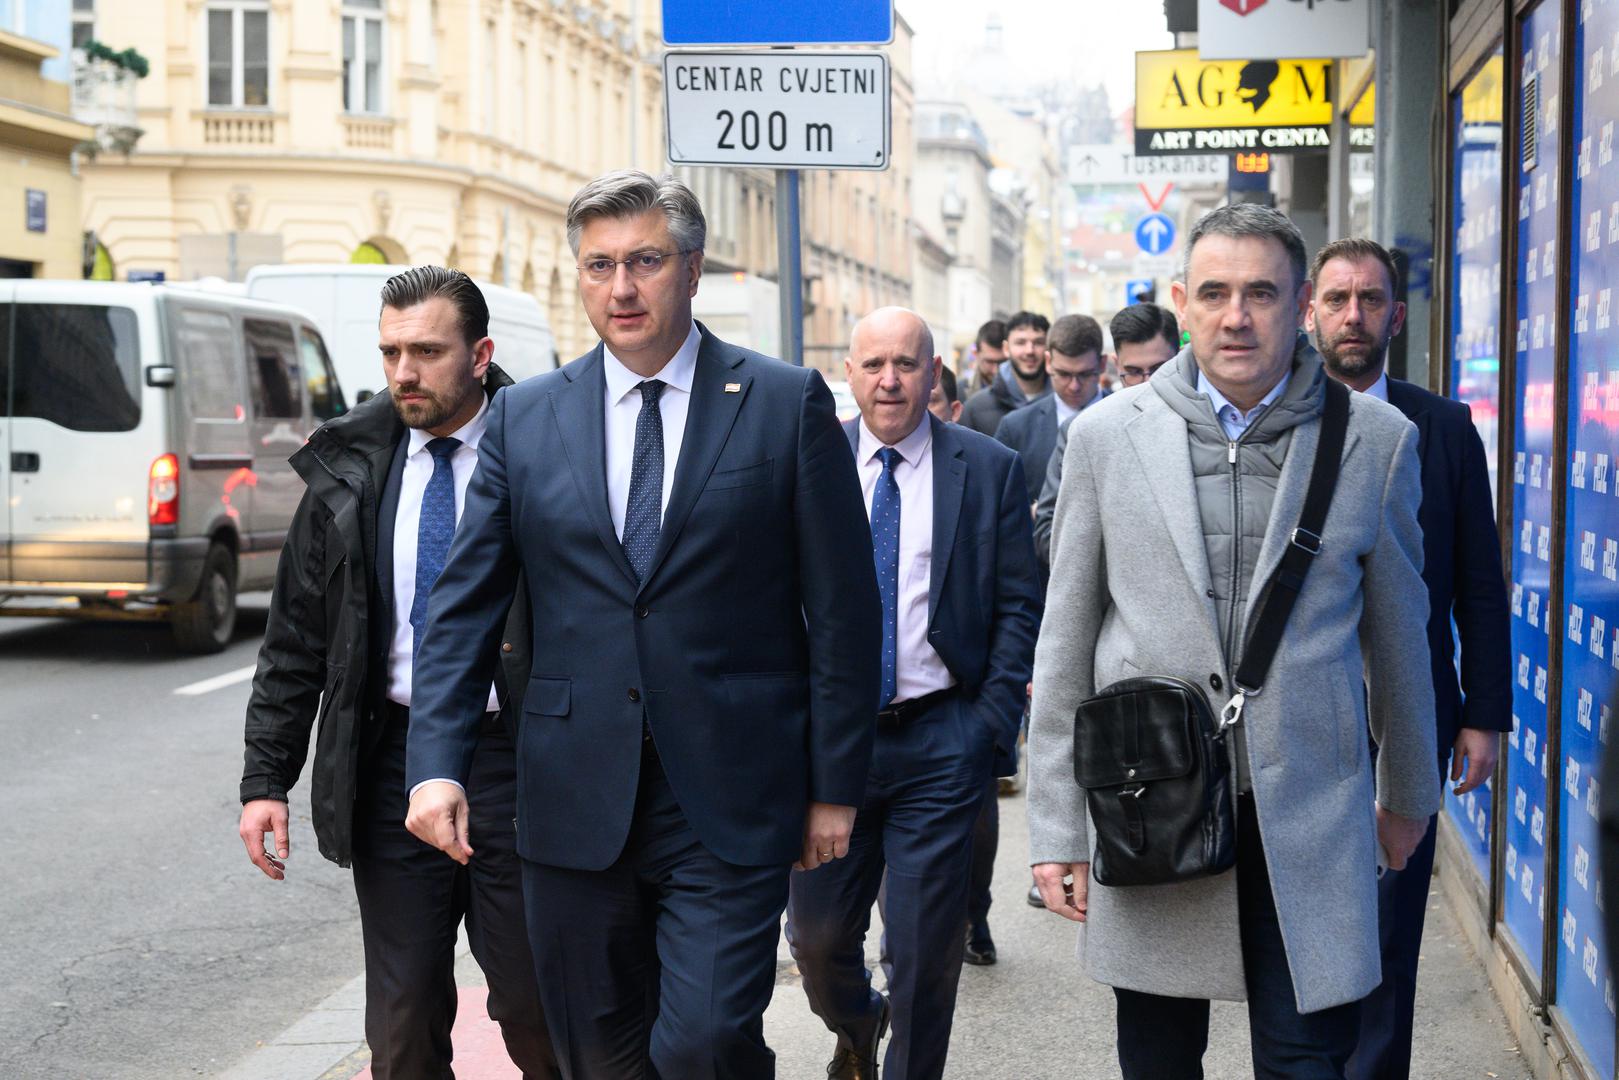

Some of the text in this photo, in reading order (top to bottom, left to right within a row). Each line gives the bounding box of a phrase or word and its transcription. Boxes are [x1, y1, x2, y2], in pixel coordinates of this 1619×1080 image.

[675, 65, 875, 94] CENTAR CVJETNI
[716, 109, 833, 152] 200 m
[1149, 130, 1193, 150] ART
[1194, 129, 1260, 149] POINT
[1261, 127, 1331, 148] CENTA
